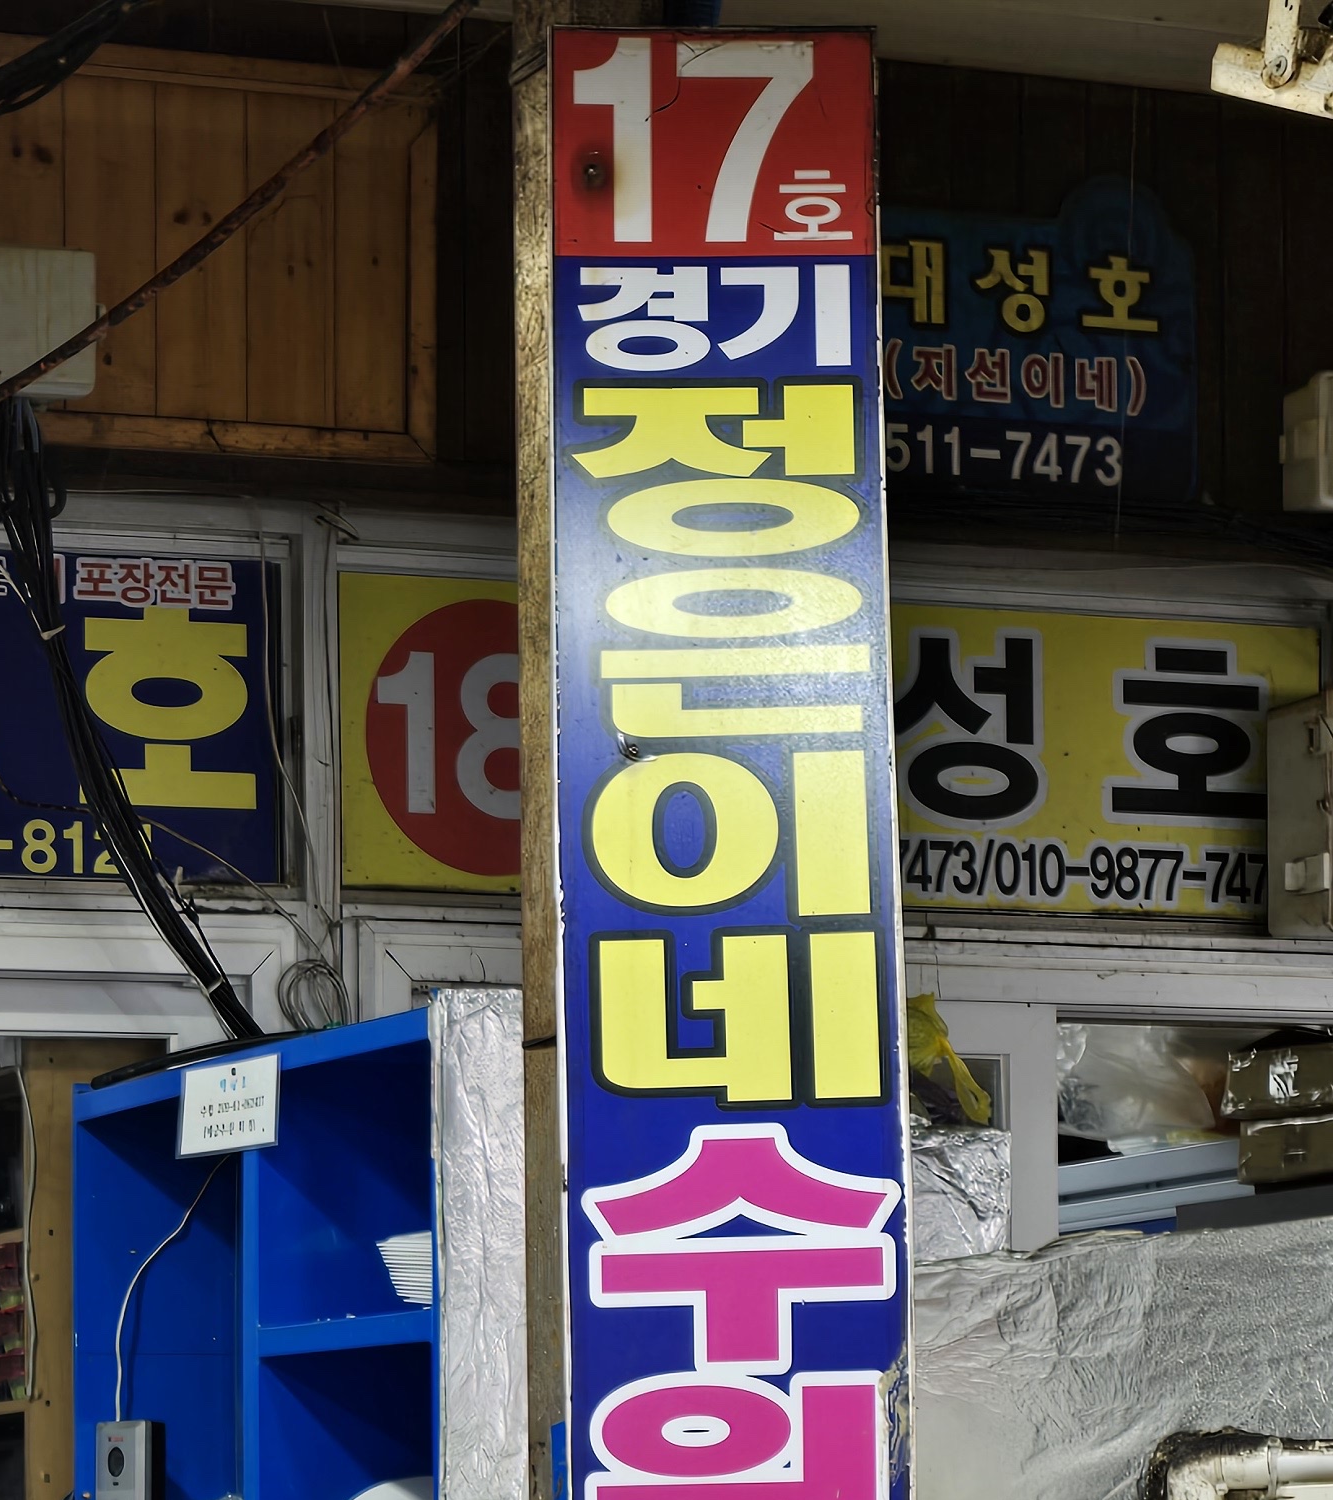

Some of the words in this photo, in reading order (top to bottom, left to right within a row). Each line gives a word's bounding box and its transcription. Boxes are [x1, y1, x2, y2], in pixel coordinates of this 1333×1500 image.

[578, 264, 851, 372] 경기
[74, 557, 236, 610] 포장전문
[570, 384, 881, 1102] 정은이네
